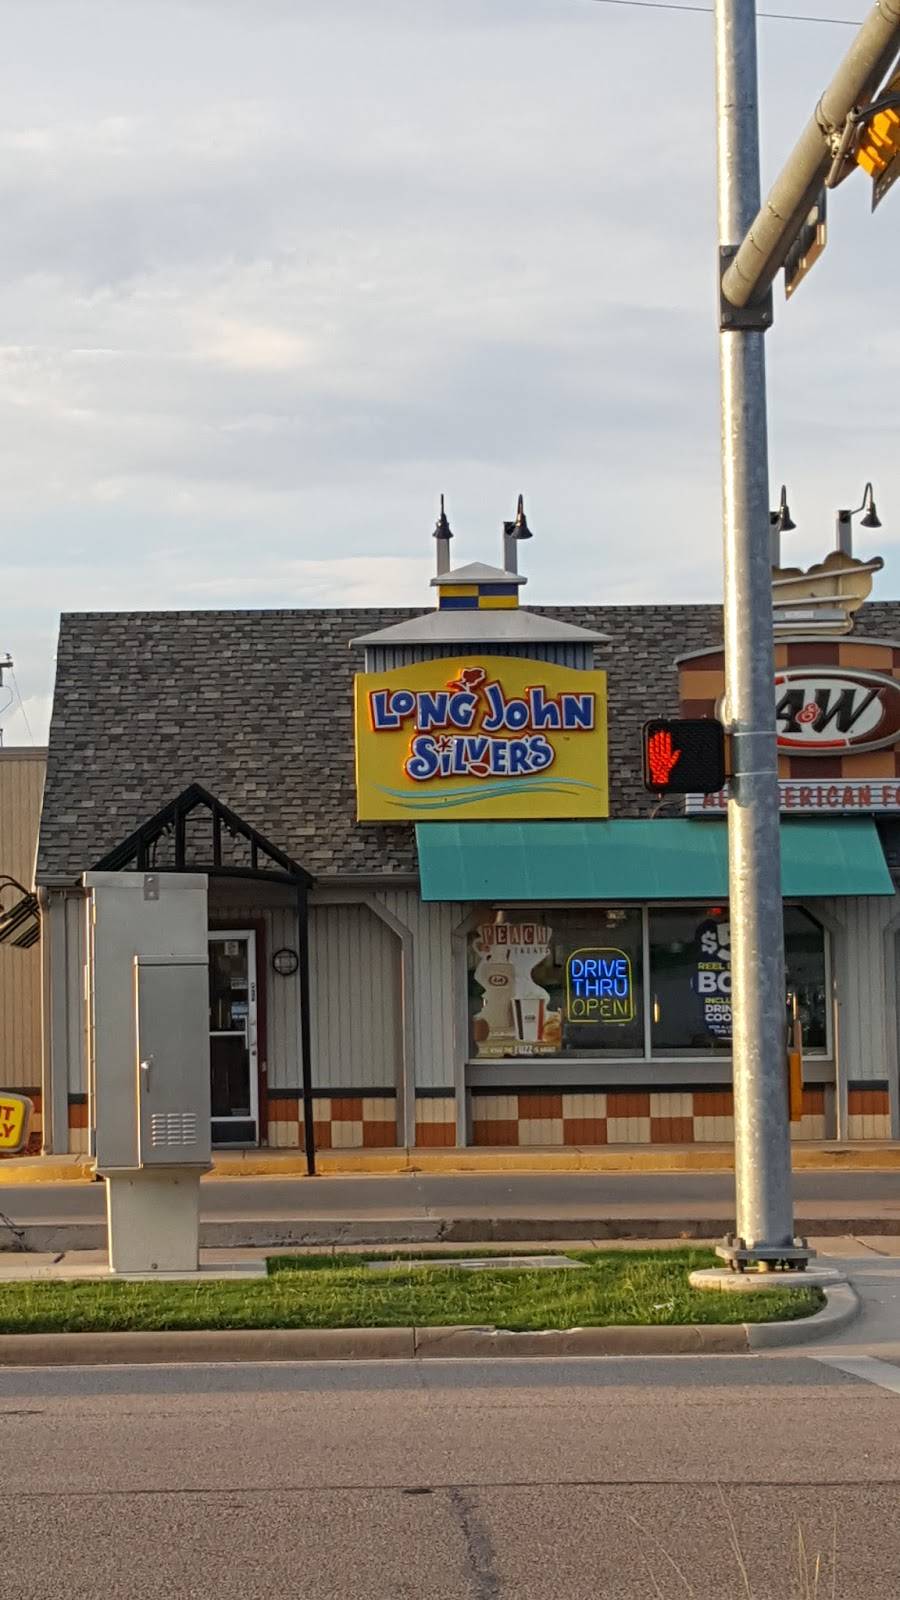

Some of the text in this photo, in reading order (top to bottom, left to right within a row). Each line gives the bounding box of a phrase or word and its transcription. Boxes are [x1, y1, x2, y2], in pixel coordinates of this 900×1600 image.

[775, 688, 885, 733] A&W
[703, 790, 729, 809] AL
[785, 785, 871, 808] ERICAN
[484, 925, 547, 944] PEACH
[571, 959, 626, 978] DRIVE
[572, 978, 627, 996] THRU
[698, 971, 732, 993] BO
[571, 999, 627, 1017] OPEN
[705, 1004, 732, 1013] DRIN
[705, 1013, 732, 1022] COO
